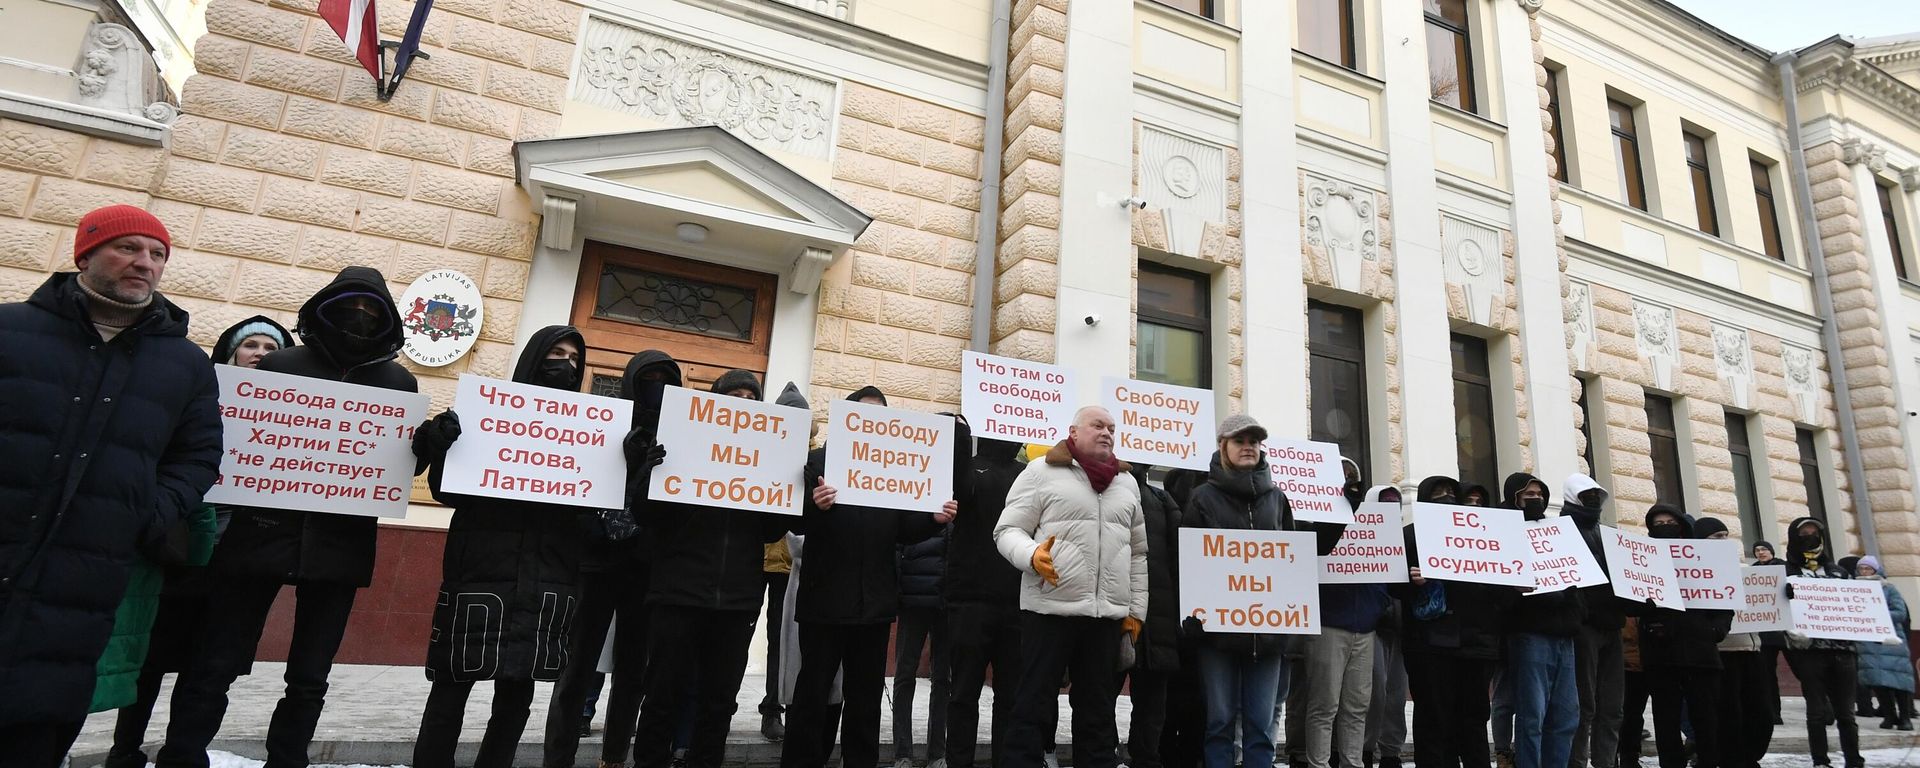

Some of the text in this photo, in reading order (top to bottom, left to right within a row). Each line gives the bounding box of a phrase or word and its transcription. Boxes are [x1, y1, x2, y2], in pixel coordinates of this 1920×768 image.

[425, 272, 471, 289] LATVIJAS
[405, 342, 461, 363] REPUBLIKA
[976, 358, 1065, 385] Что там со
[236, 382, 406, 418] Свобода слова
[979, 381, 1062, 403] свободой
[1115, 386, 1200, 416] Свободу
[479, 384, 614, 422] Что там со
[993, 402, 1049, 423] слова,
[688, 396, 787, 440] Марат,
[1122, 409, 1194, 438] Марату
[338, 421, 352, 432] в
[358, 420, 386, 437] Ст.
[395, 425, 414, 440] 11
[480, 417, 605, 446] свободой
[846, 412, 939, 447] Свободу
[985, 418, 1058, 441] Латвия?
[248, 428, 330, 452] Хартии
[1120, 432, 1197, 460] Касему!
[498, 447, 582, 474] слова,
[711, 443, 760, 467] мы
[852, 441, 931, 473] Марату
[270, 456, 386, 480] действует
[1271, 464, 1316, 478] слова
[232, 474, 366, 500] территории
[372, 486, 402, 502] ЕС
[480, 468, 593, 498] Латвия?
[664, 475, 794, 508] с тобой!
[847, 468, 932, 500] Касему!
[1272, 480, 1344, 497] ободном
[1290, 499, 1332, 512] дении
[1452, 512, 1486, 531] ЕС,
[1340, 530, 1376, 540] лова
[1528, 525, 1561, 542] ртия
[1203, 534, 1294, 564] Марат,
[1330, 543, 1403, 560] вободном
[1445, 536, 1500, 552] готов
[1532, 540, 1554, 554] ЕС
[1616, 534, 1658, 555] Хартия
[1670, 544, 1700, 560] ЕС,
[1327, 562, 1388, 575] падении
[1428, 556, 1524, 576] осудить?
[1632, 553, 1648, 568] ЕС
[1228, 574, 1272, 592] мы
[1540, 570, 1582, 587] из ЕС
[1624, 568, 1665, 586] вышла
[1744, 574, 1778, 588] ободу
[1632, 586, 1664, 602] из ЕС
[1680, 586, 1735, 601] дить?
[1792, 583, 1837, 593] Свобода
[1794, 594, 1840, 602] ащищена
[1746, 592, 1776, 606] арату
[1808, 604, 1844, 612] Хартии
[1216, 603, 1309, 628] тобой!
[1736, 608, 1781, 624] Касему!
[1823, 614, 1876, 624] действует
[1810, 624, 1872, 634] территории
[1876, 626, 1890, 634] ЕС
